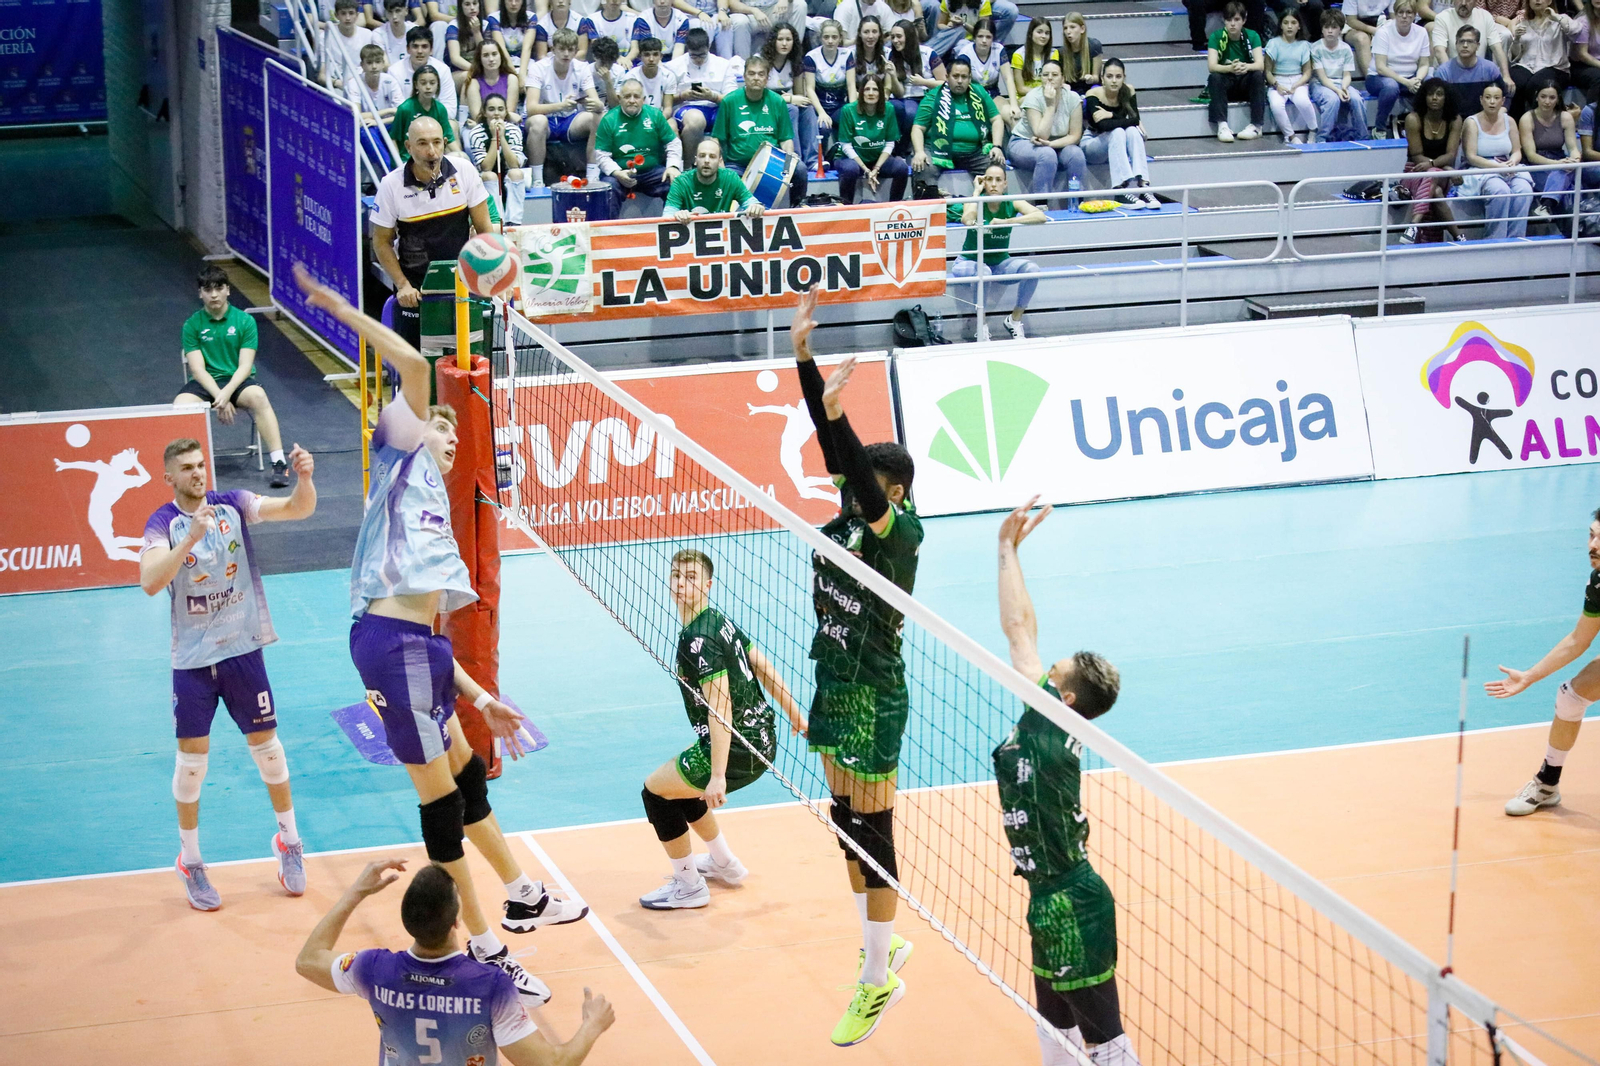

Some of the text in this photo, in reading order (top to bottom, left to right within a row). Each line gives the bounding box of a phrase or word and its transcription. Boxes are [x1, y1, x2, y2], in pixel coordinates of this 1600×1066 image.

[878, 230, 923, 241] LA UNION
[887, 221, 914, 230] PEÑA
[601, 254, 862, 306] LA UNION
[1550, 368, 1600, 401] CO
[1070, 379, 1338, 463] Unicaja
[577, 495, 666, 524] VOLEIBOL
[669, 483, 776, 515] MASCULIA
[257, 690, 271, 715] 9
[374, 985, 482, 1015] LUCAS LORENTE
[415, 1018, 443, 1065] 5
